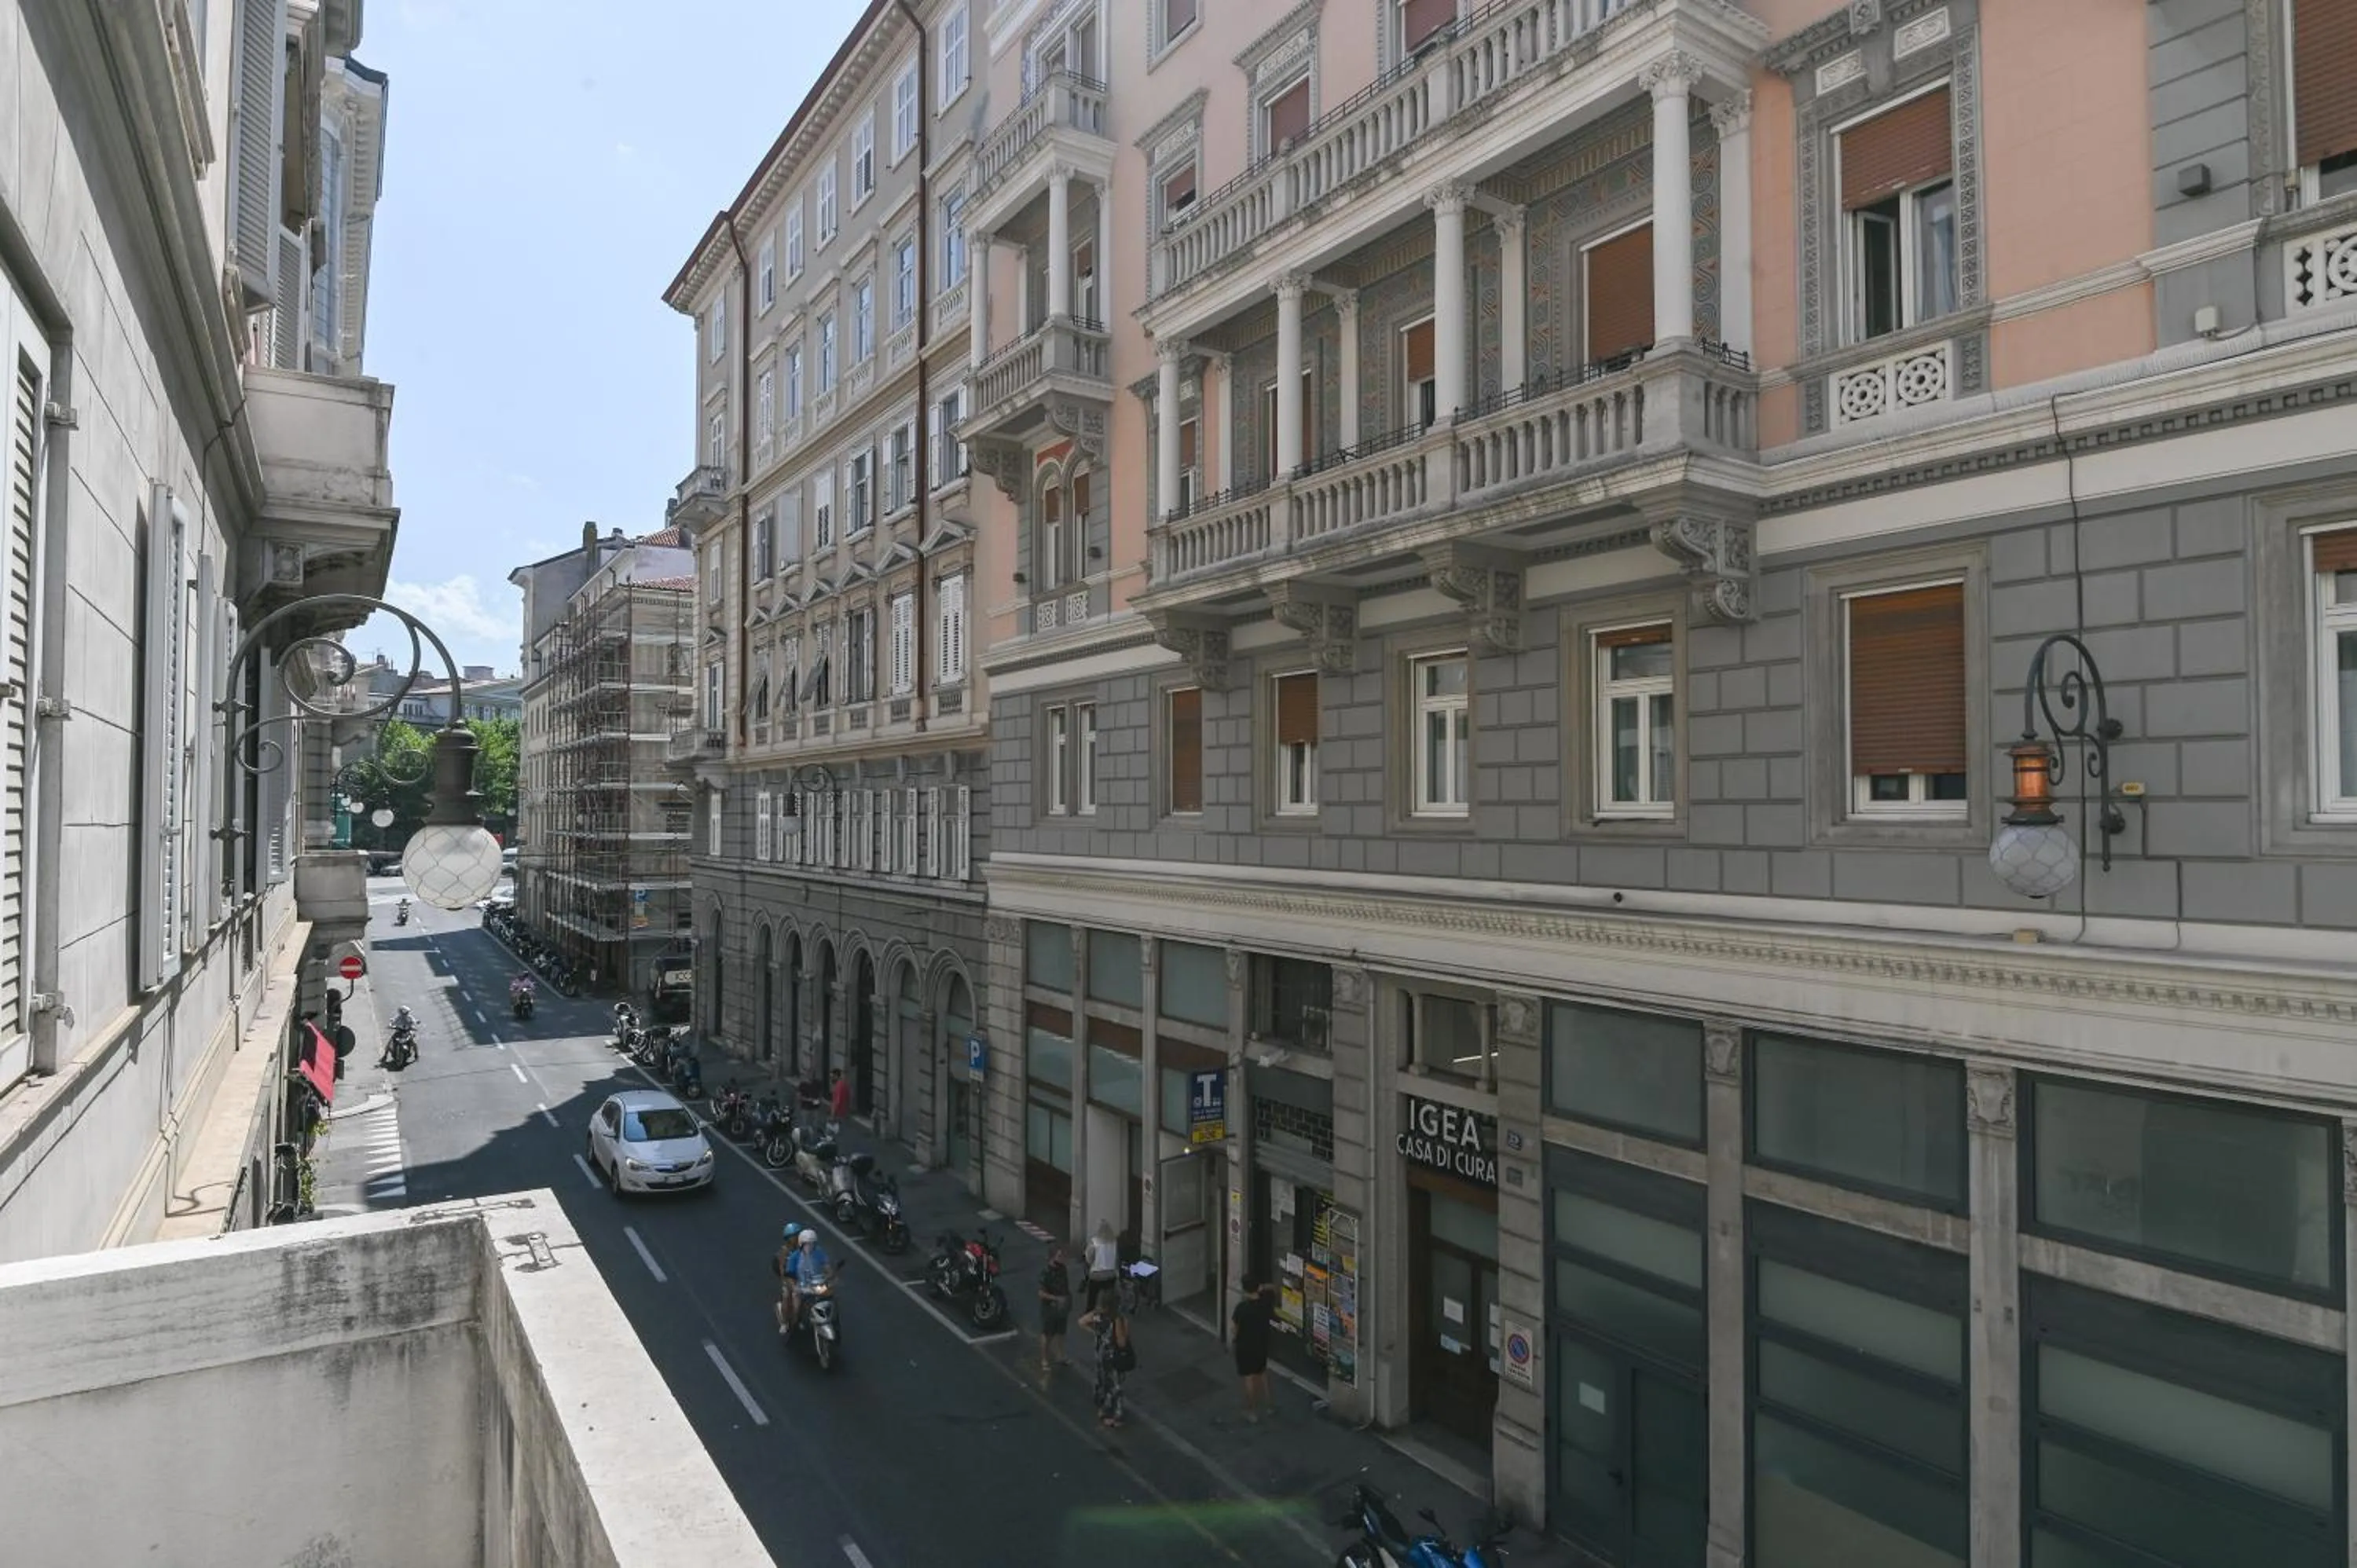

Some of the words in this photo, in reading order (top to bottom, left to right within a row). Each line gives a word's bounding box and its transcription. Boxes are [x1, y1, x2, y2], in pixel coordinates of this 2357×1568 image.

[970, 1039, 981, 1066] P
[1410, 1099, 1480, 1151] IGEA
[1396, 1134, 1433, 1163] CASA
[1437, 1145, 1450, 1169] DI
[1455, 1152, 1496, 1185] CURA
